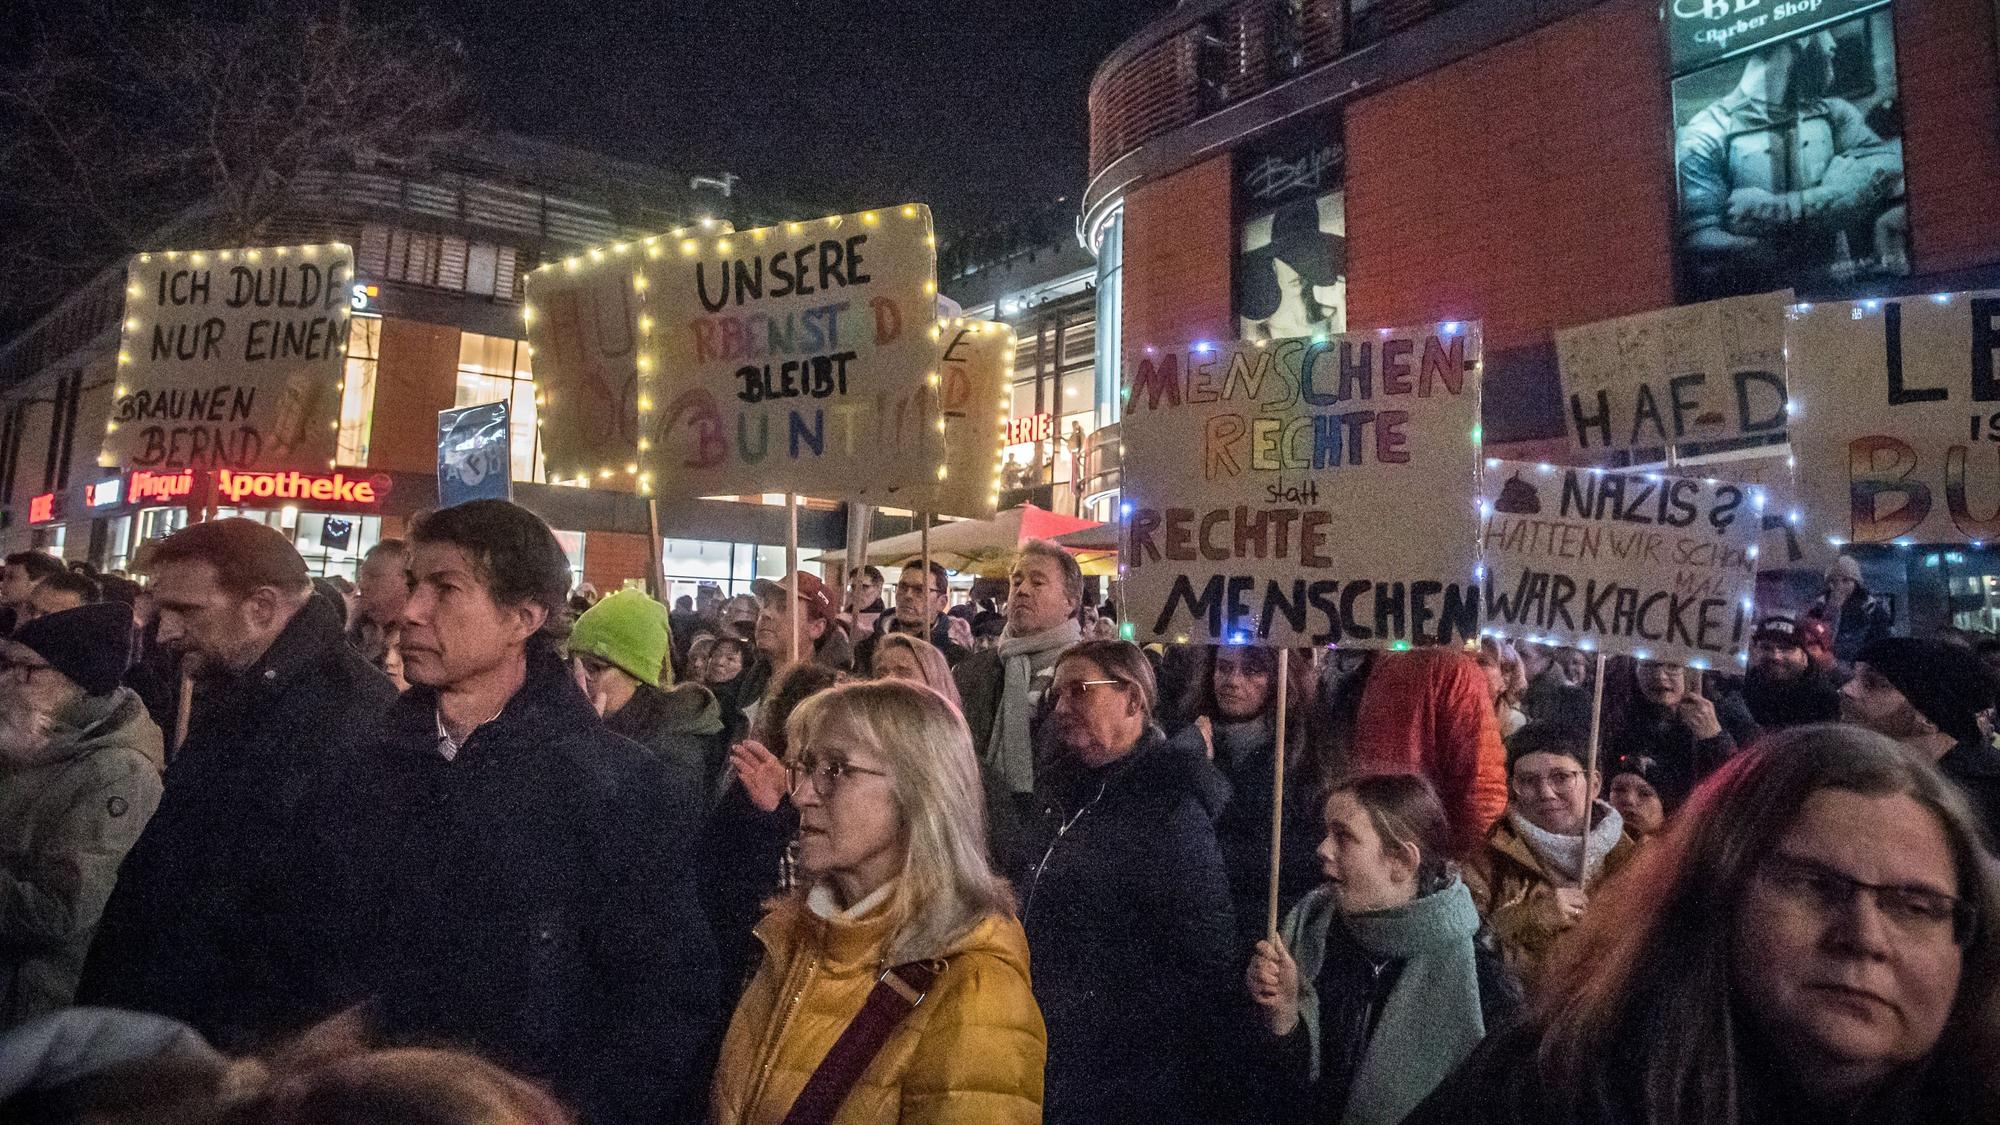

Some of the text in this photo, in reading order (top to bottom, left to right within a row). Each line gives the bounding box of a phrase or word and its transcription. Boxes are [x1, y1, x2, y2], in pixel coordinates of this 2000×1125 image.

[1772, 0, 1822, 21] Shop
[157, 260, 348, 310] ICH DULDE
[696, 234, 871, 312] UNSERE
[150, 317, 348, 362] NUR EINEN
[735, 351, 857, 403] BLEIBT
[1127, 336, 1464, 414] MENSCHEN
[113, 386, 257, 423] BRAUNEN
[132, 425, 263, 468] BERND
[1204, 409, 1411, 480] RECHTE
[218, 468, 376, 503] Apotheke
[1128, 506, 1333, 569] RECHTE
[1484, 517, 1601, 561] HATTEN
[1609, 528, 1664, 563] WIR
[1152, 575, 1480, 647] MENSCHEN
[1484, 566, 1746, 657] WAR KACKE!
